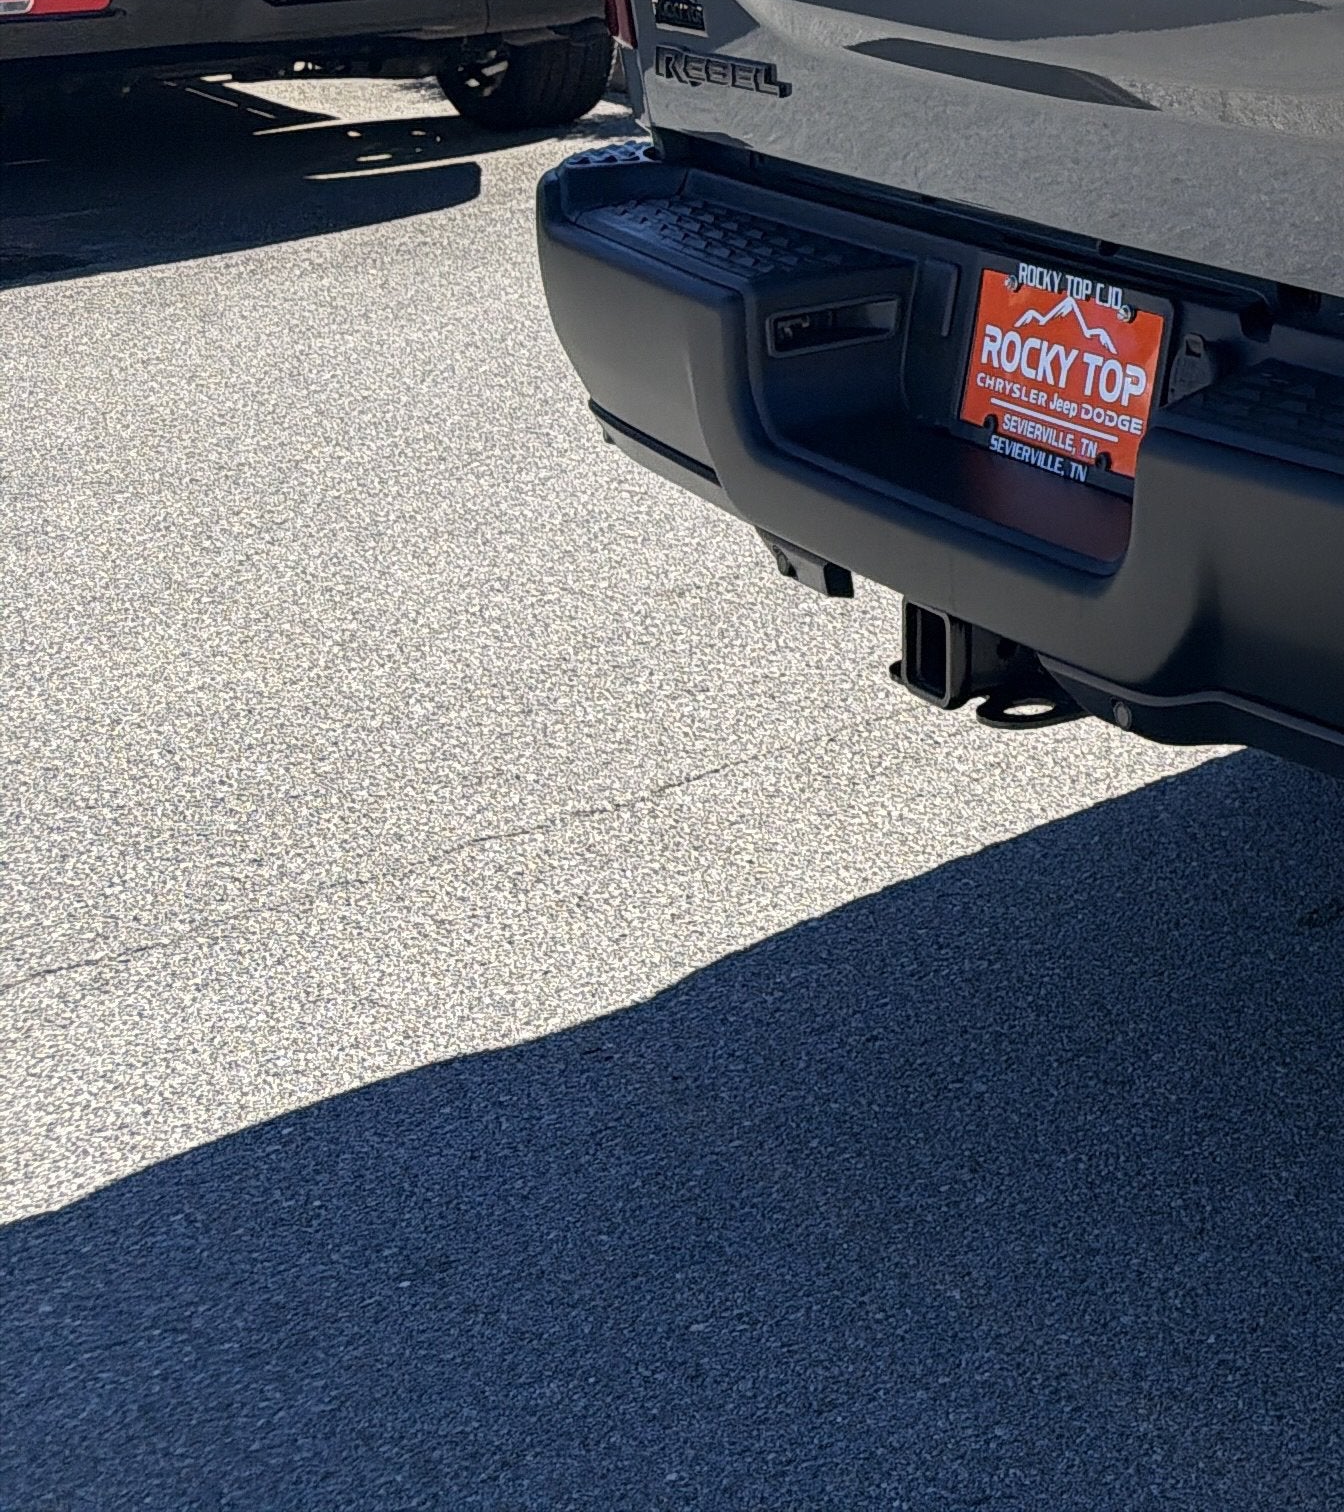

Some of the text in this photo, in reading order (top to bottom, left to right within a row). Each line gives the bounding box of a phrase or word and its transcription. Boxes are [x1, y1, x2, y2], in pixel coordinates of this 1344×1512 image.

[656, 44, 793, 99] REBEL
[1018, 262, 1122, 309] ROCKY TOP CJD
[980, 324, 1147, 407] ROCKY TOP
[976, 373, 1144, 436] CHRYSLER Jeep DODGE
[989, 434, 1088, 483] SEVIERVILLE, TN
[1002, 414, 1098, 458] SEVIERVILLE, TN
